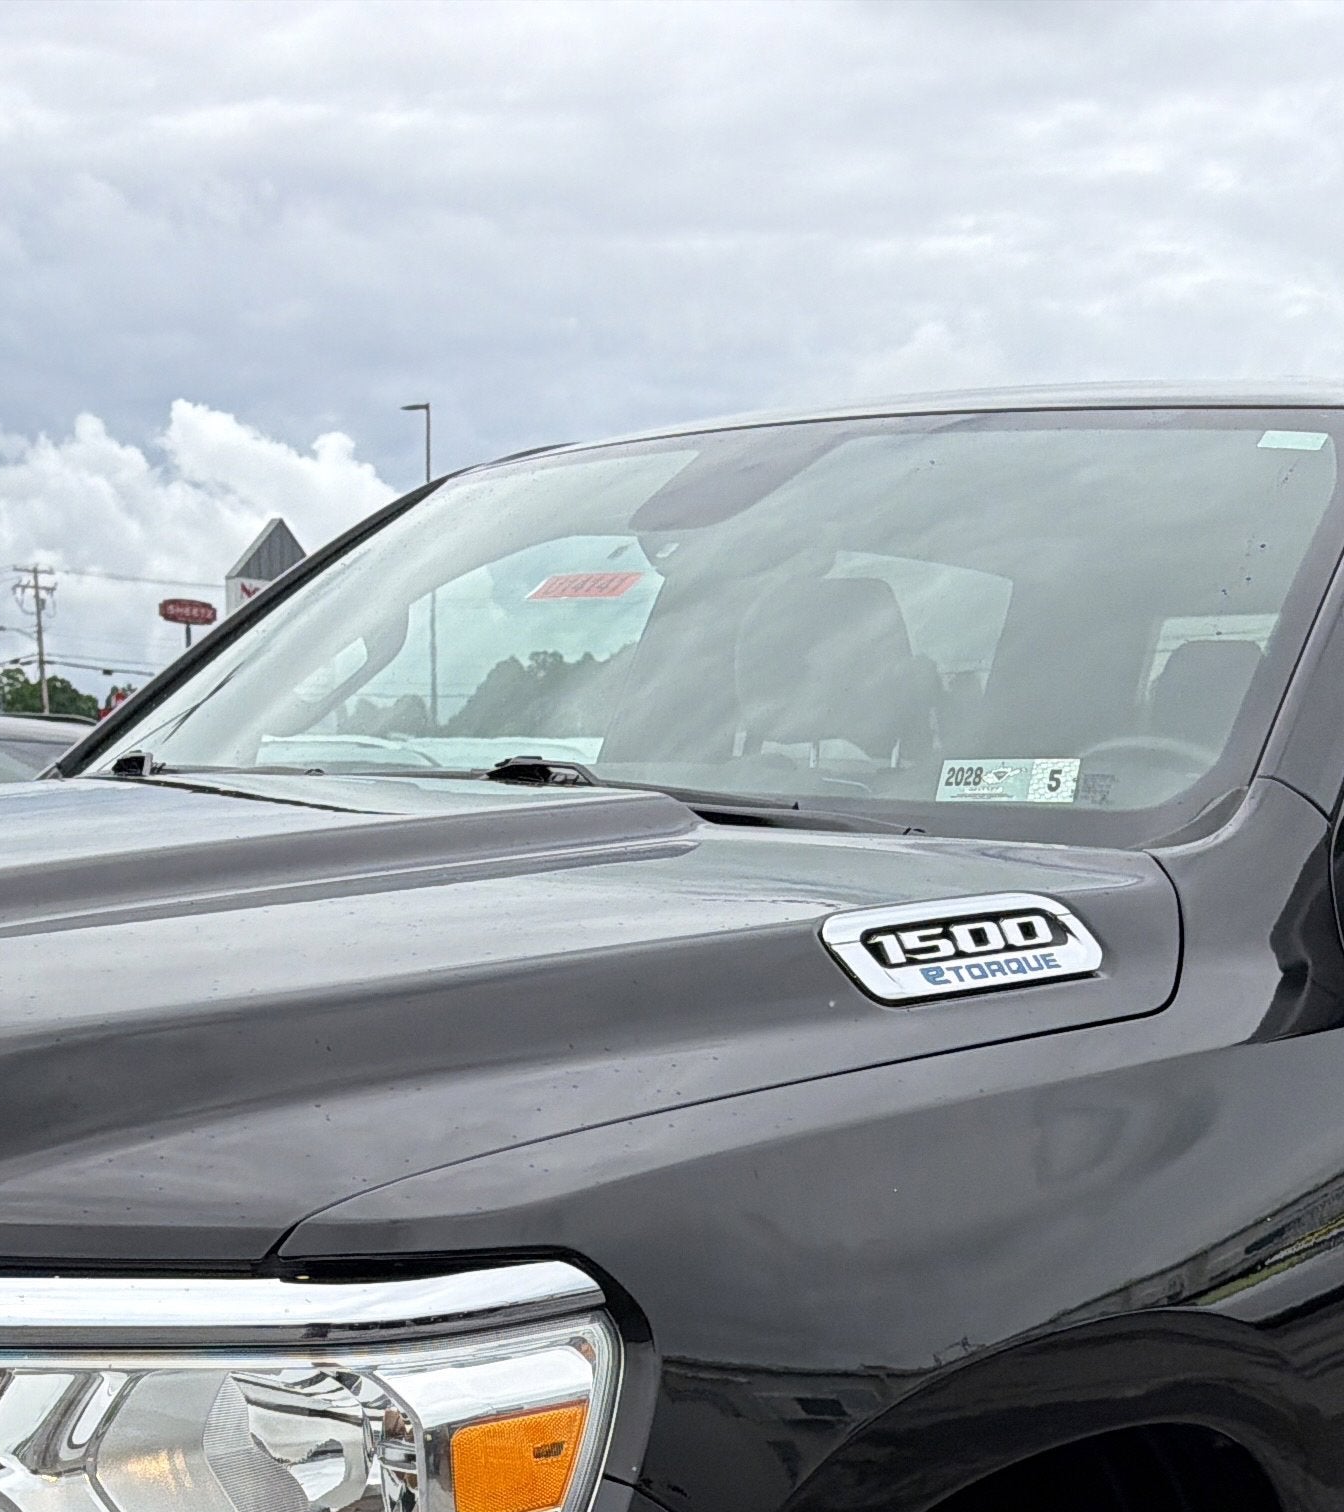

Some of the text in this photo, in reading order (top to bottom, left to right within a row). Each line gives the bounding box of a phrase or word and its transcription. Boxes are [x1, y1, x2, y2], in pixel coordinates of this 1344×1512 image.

[944, 766, 1063, 792] 2028 5
[866, 914, 1056, 965] 1500
